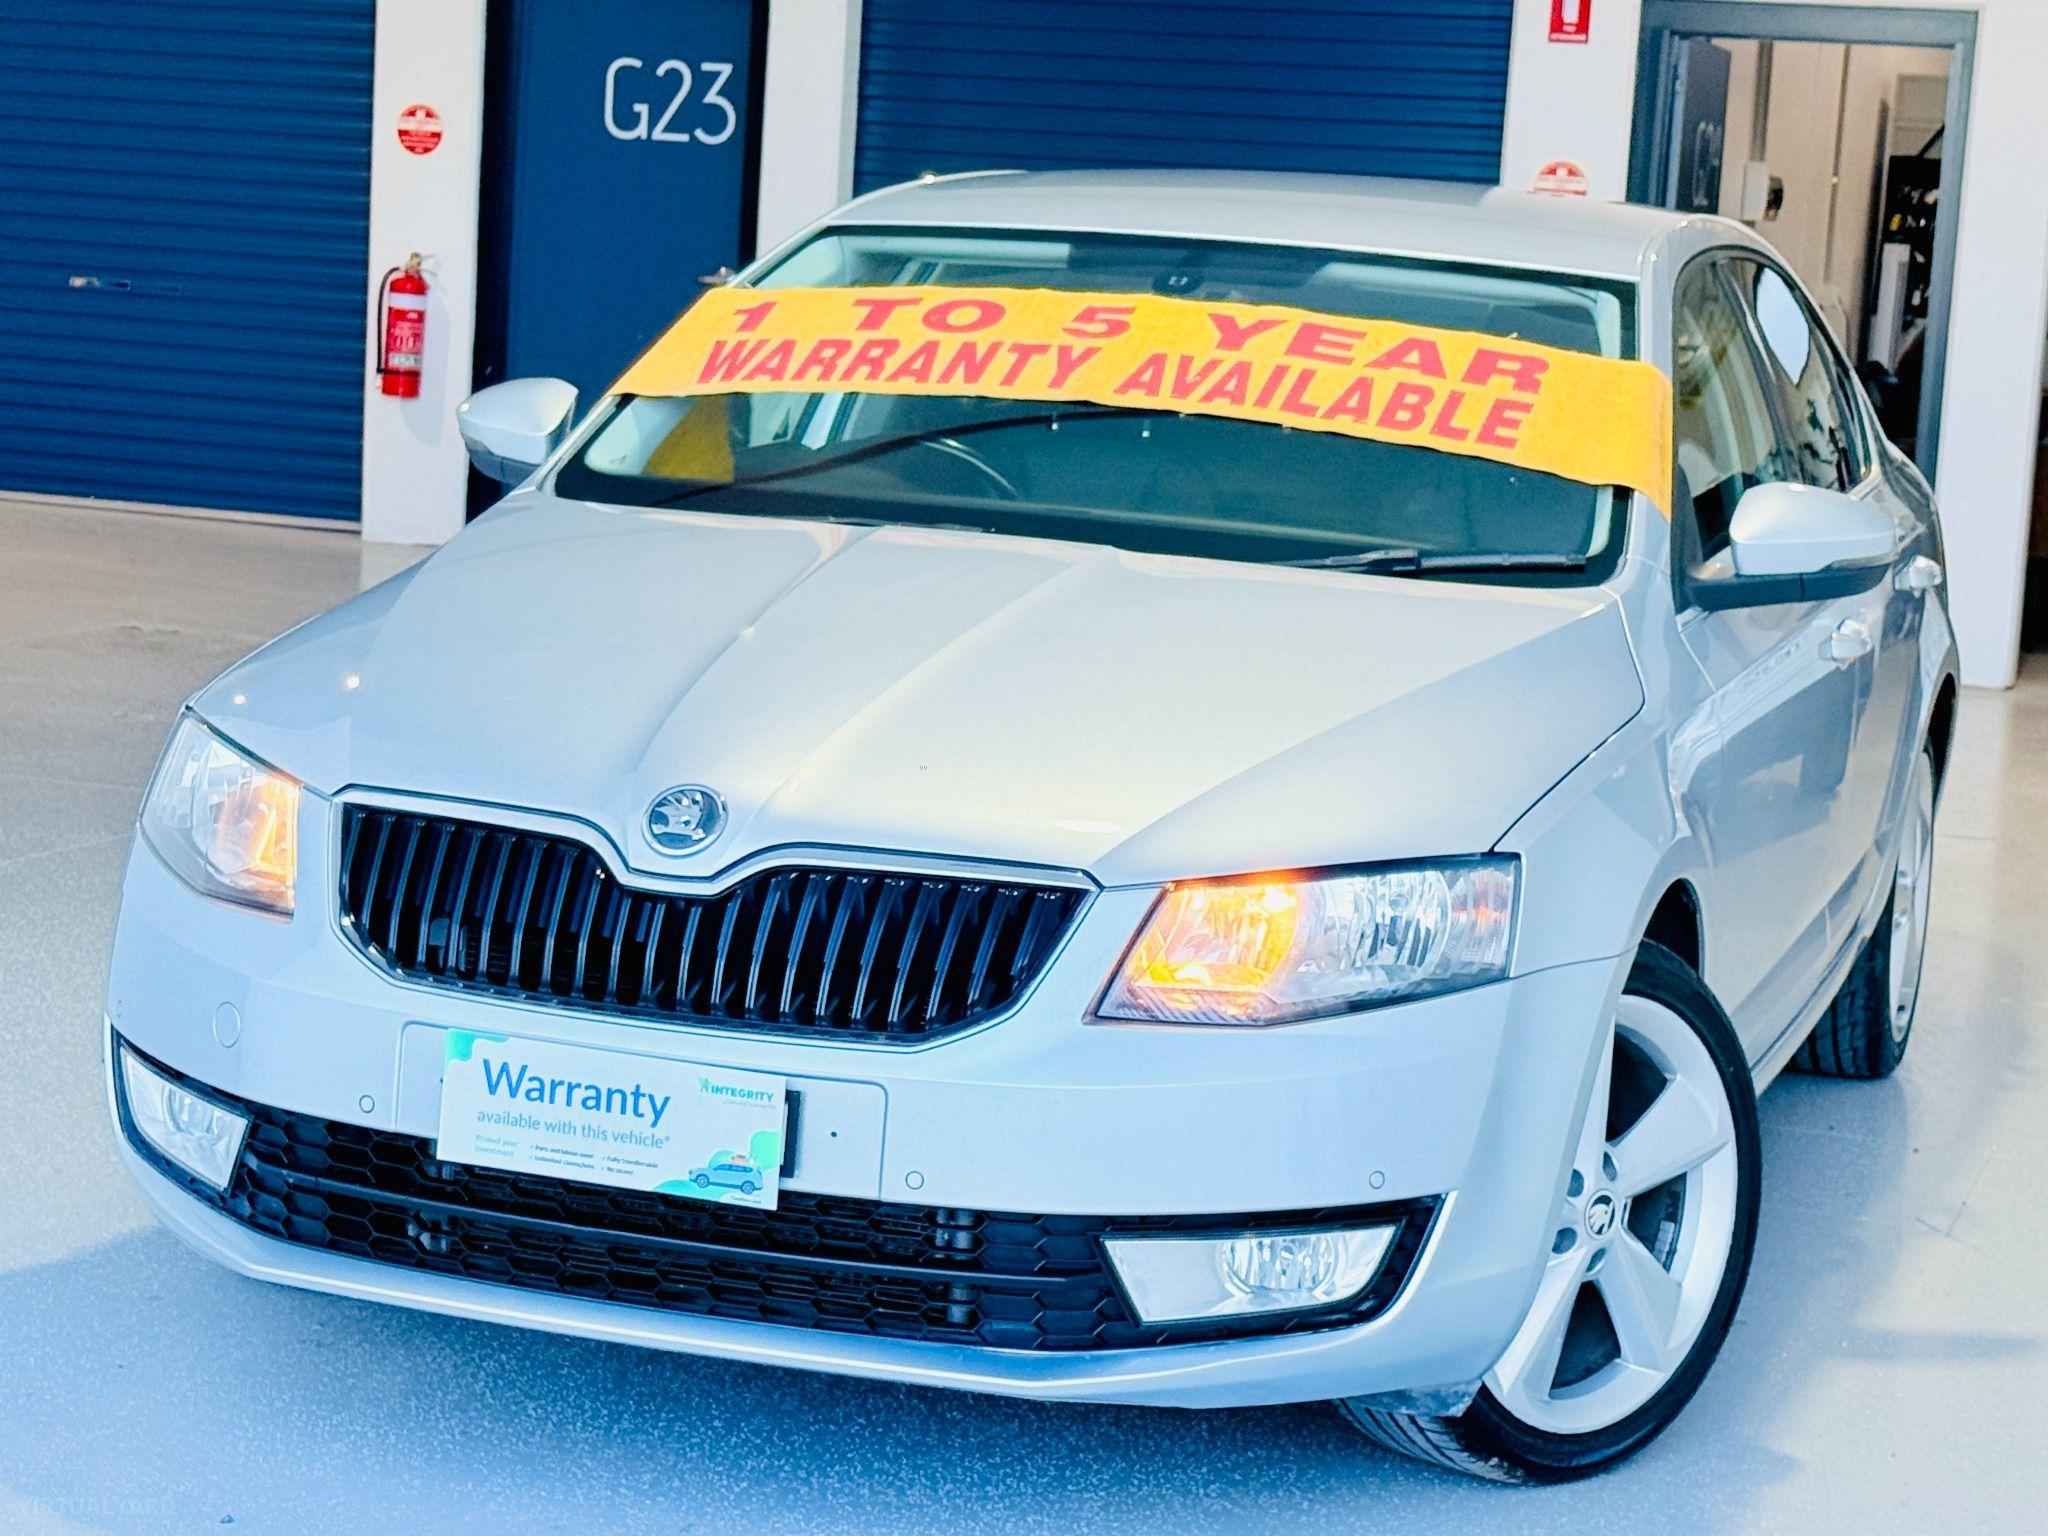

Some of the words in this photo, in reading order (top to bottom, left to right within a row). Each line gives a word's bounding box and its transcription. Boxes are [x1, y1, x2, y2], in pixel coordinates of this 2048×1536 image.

[603, 56, 737, 146] G23
[733, 301, 778, 333] 1
[852, 297, 1007, 334] TO
[1062, 306, 1137, 339] 5
[1207, 312, 1550, 394] YEAR
[696, 339, 1103, 389] WARRANTY
[1113, 352, 1534, 449] AVAILABLE
[477, 1110, 540, 1130] available
[544, 1120, 578, 1136] with
[581, 1124, 608, 1141] this
[482, 1057, 671, 1129] Warranty
[711, 1085, 775, 1102] INTEGRITY
